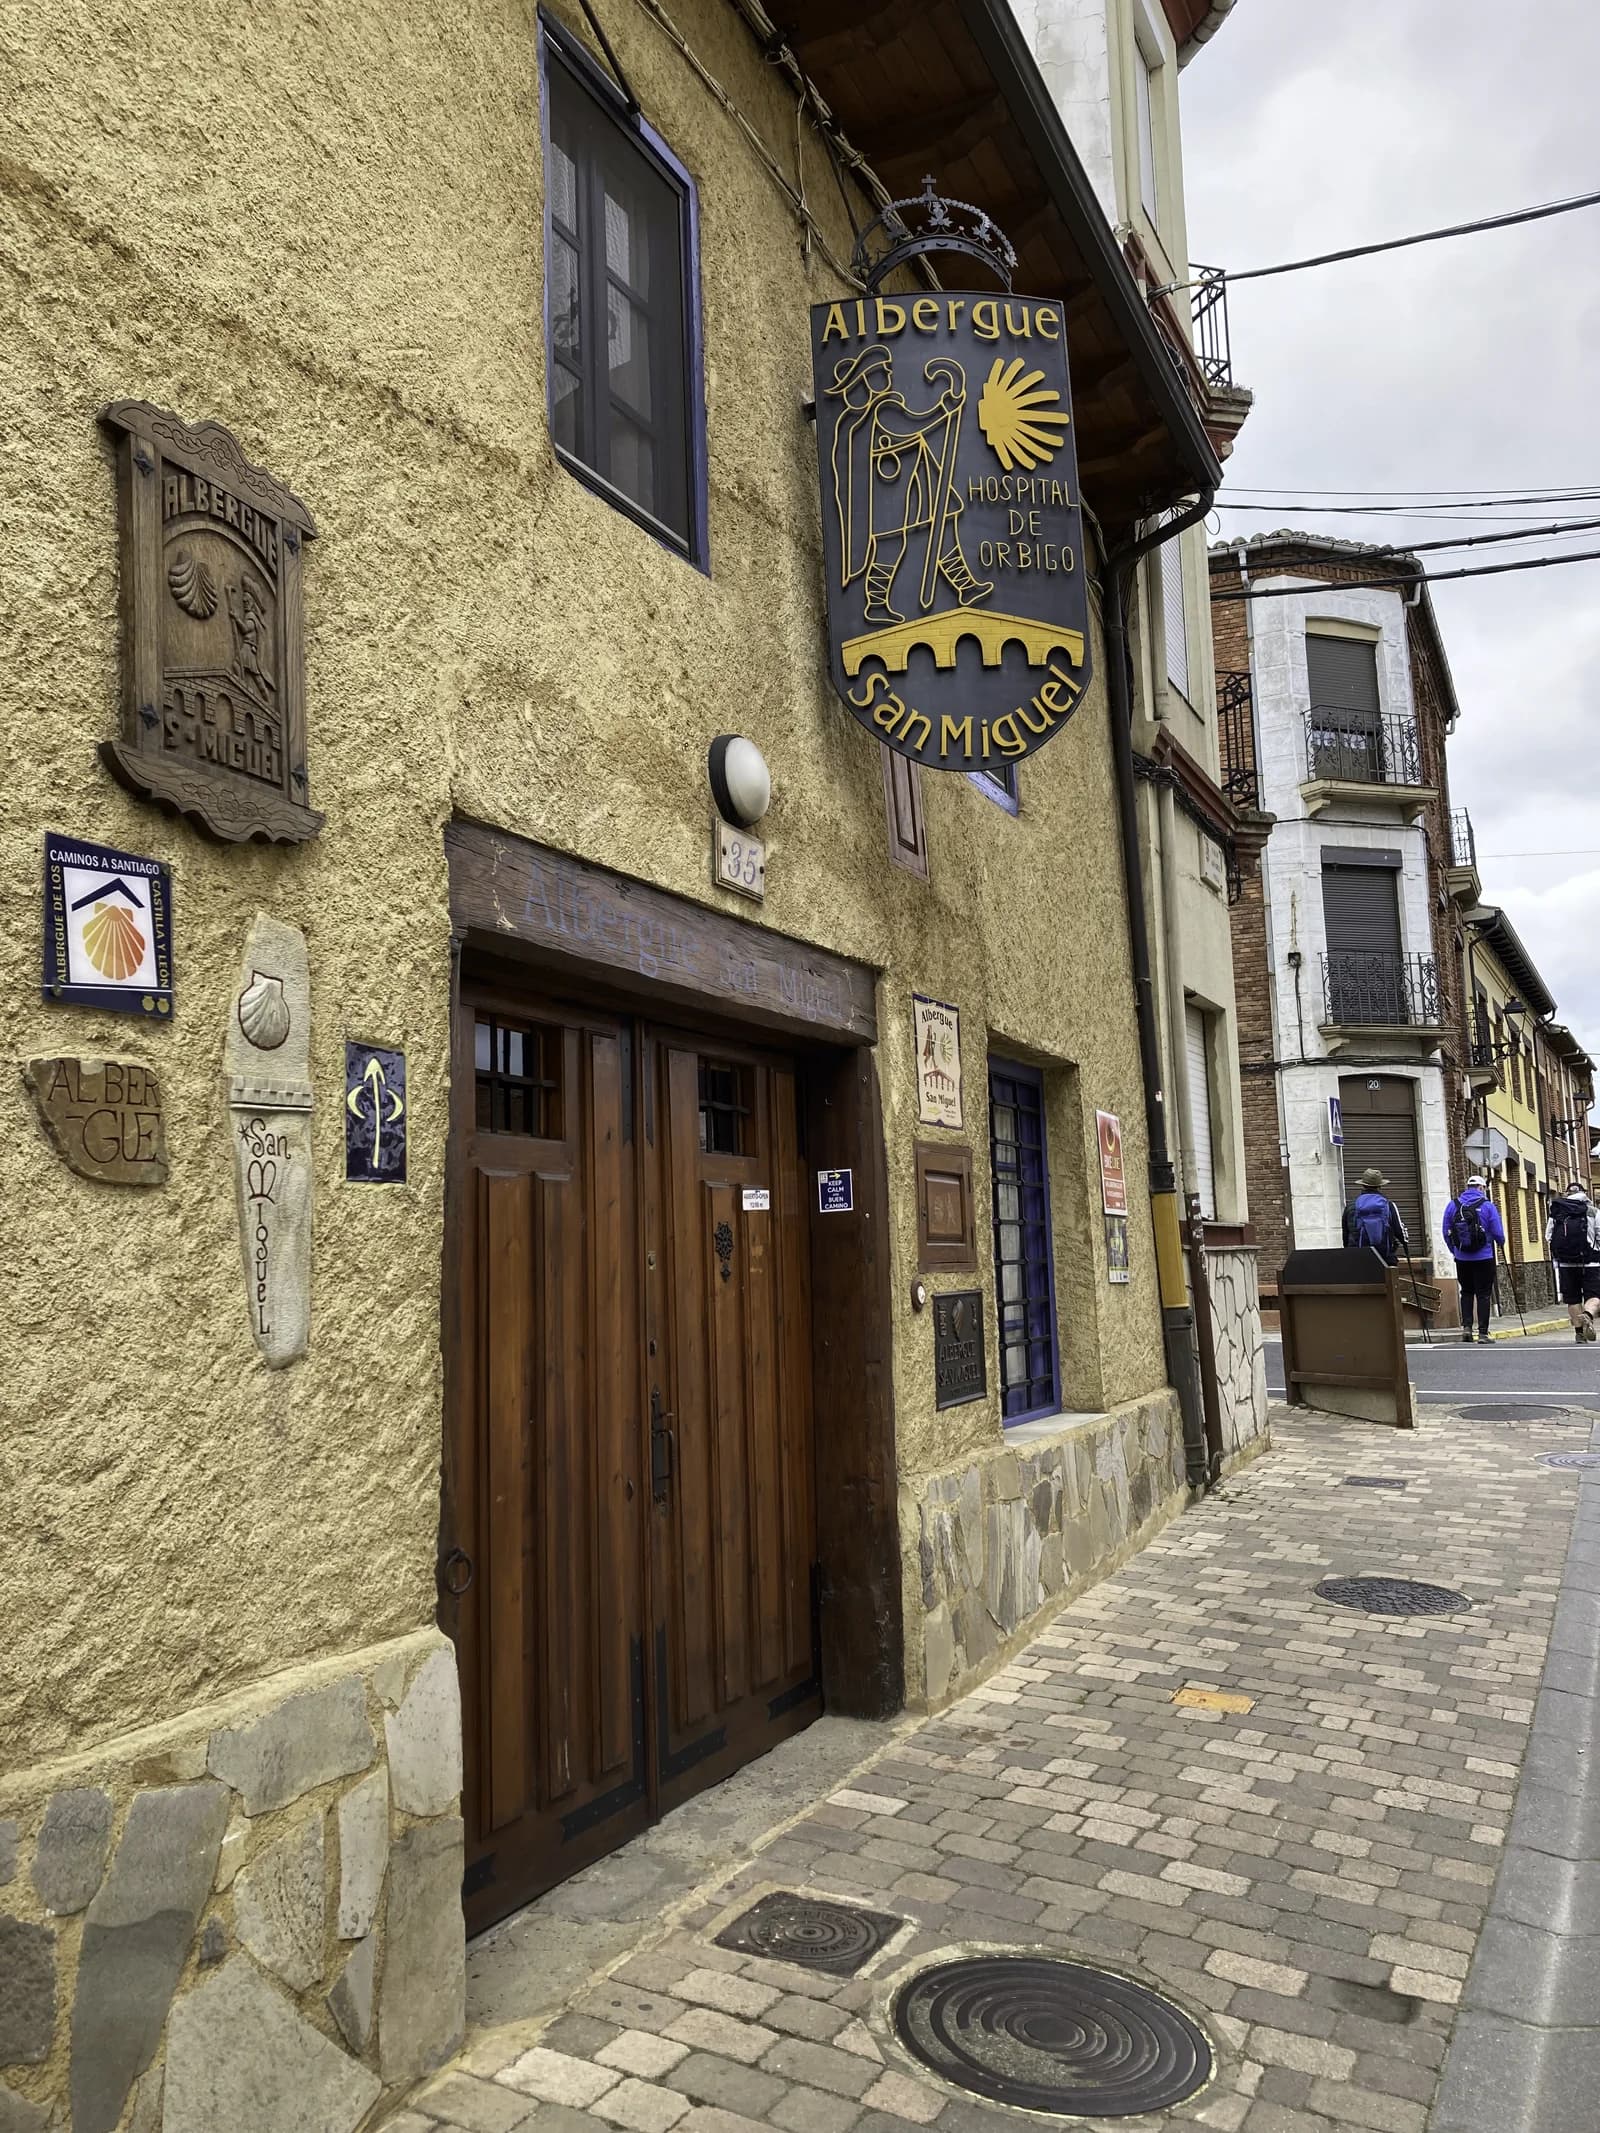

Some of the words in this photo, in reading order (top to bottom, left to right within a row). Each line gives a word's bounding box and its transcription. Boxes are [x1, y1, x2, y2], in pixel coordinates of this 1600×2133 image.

[821, 298, 1060, 343] Albergue
[967, 474, 1079, 508] HOSPITAL
[164, 474, 278, 577] ALBERGUE
[1008, 509, 1043, 536] DE
[980, 541, 1075, 572] ORBIGO
[848, 673, 932, 751] San
[940, 664, 1083, 758] Miguel
[197, 725, 283, 786] MIGUEL
[49, 849, 98, 867] CAMINOS
[101, 858, 110, 869] A
[111, 859, 160, 875] SANTIAGO
[51, 865, 61, 890] LOS
[727, 841, 758, 885] 35
[53, 893, 63, 913] DE
[152, 880, 165, 941] CASTILLA
[523, 862, 699, 978] Albergue
[54, 915, 66, 984] ALBERGUE
[156, 943, 167, 951] Y
[158, 954, 169, 988] LEÓN
[921, 1008, 953, 1031] Albergue
[925, 1091, 938, 1104] San
[1368, 1079, 1379, 1089] 20
[828, 1179, 843, 1187] KEEP
[824, 1202, 849, 1210] CAMINO
